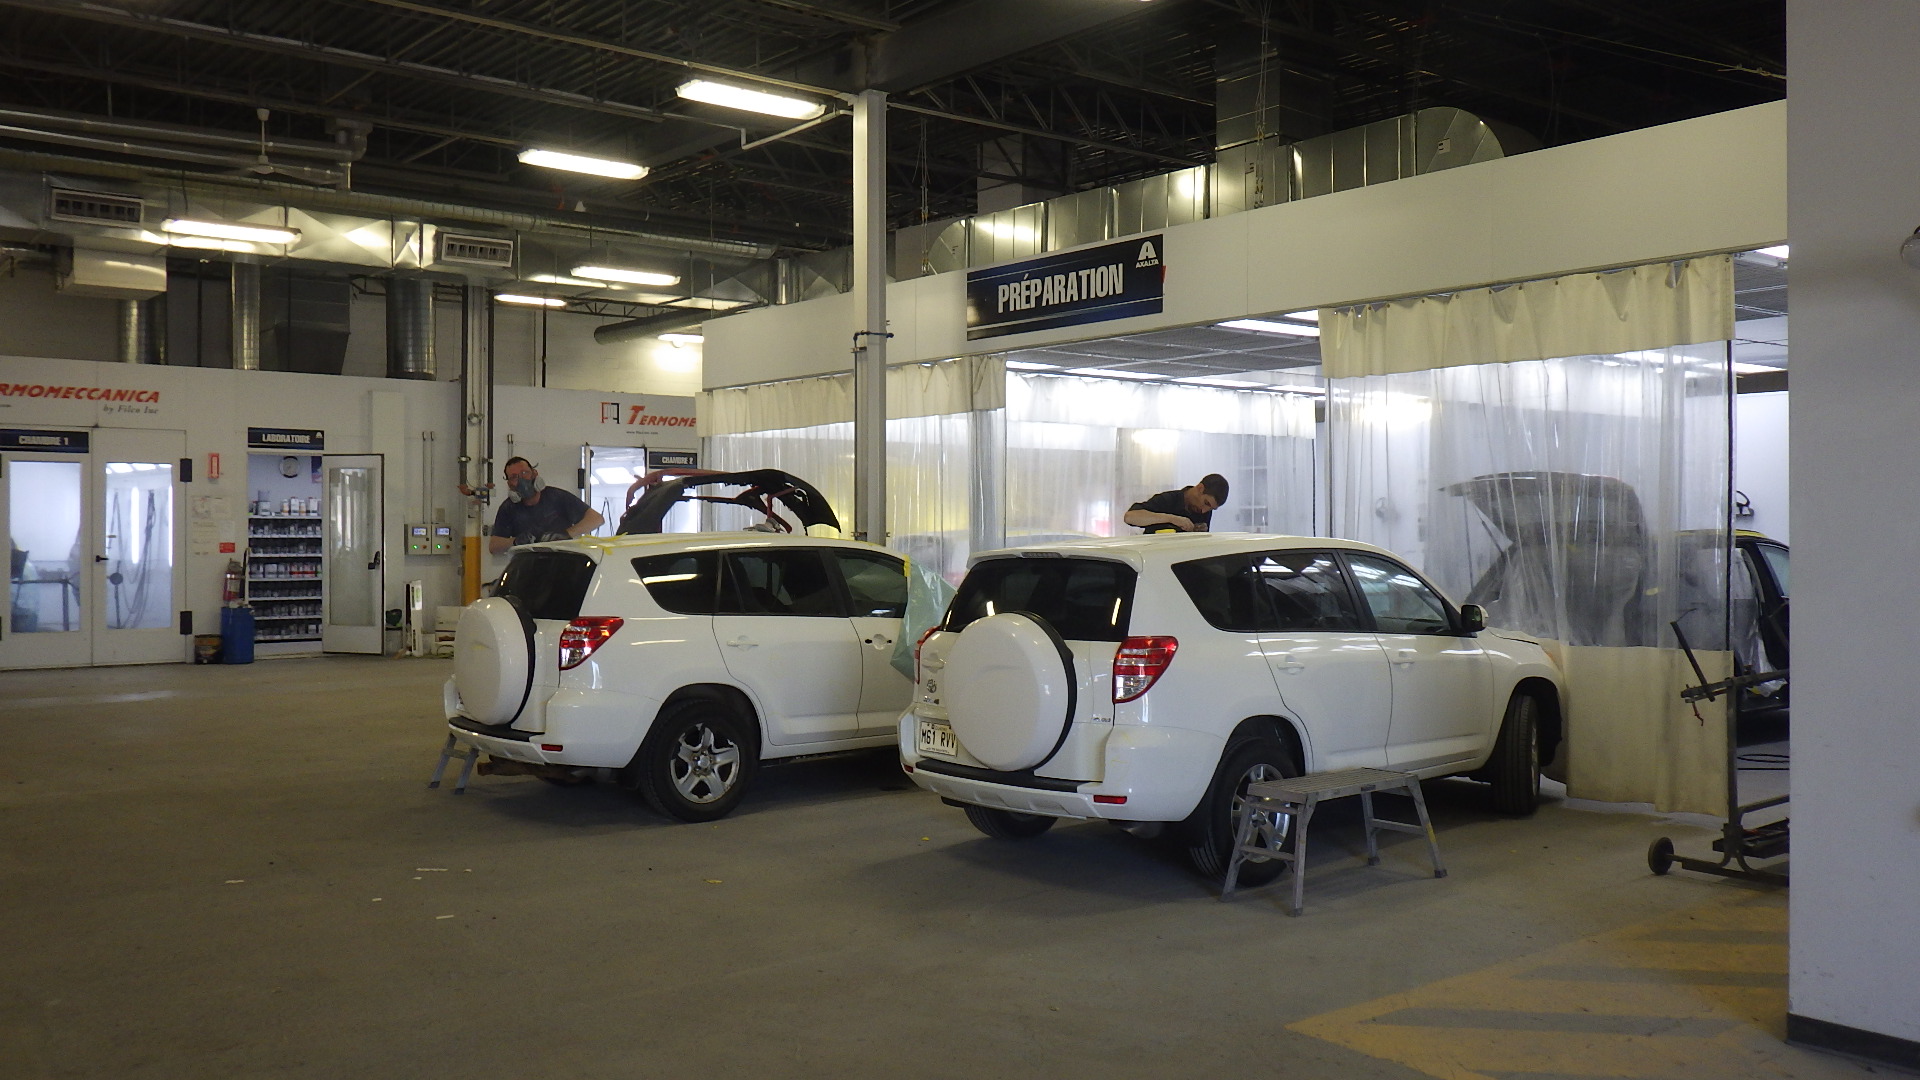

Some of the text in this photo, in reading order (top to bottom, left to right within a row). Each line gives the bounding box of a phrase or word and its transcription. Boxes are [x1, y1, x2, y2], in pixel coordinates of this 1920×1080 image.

[1135, 258, 1160, 269] AXALTA
[998, 263, 1123, 313] PRÉPARATION
[0, 383, 160, 404] RMOMECCANICA
[103, 404, 114, 414] by
[262, 434, 310, 444] LABORATOIRE
[921, 729, 936, 745] M61
